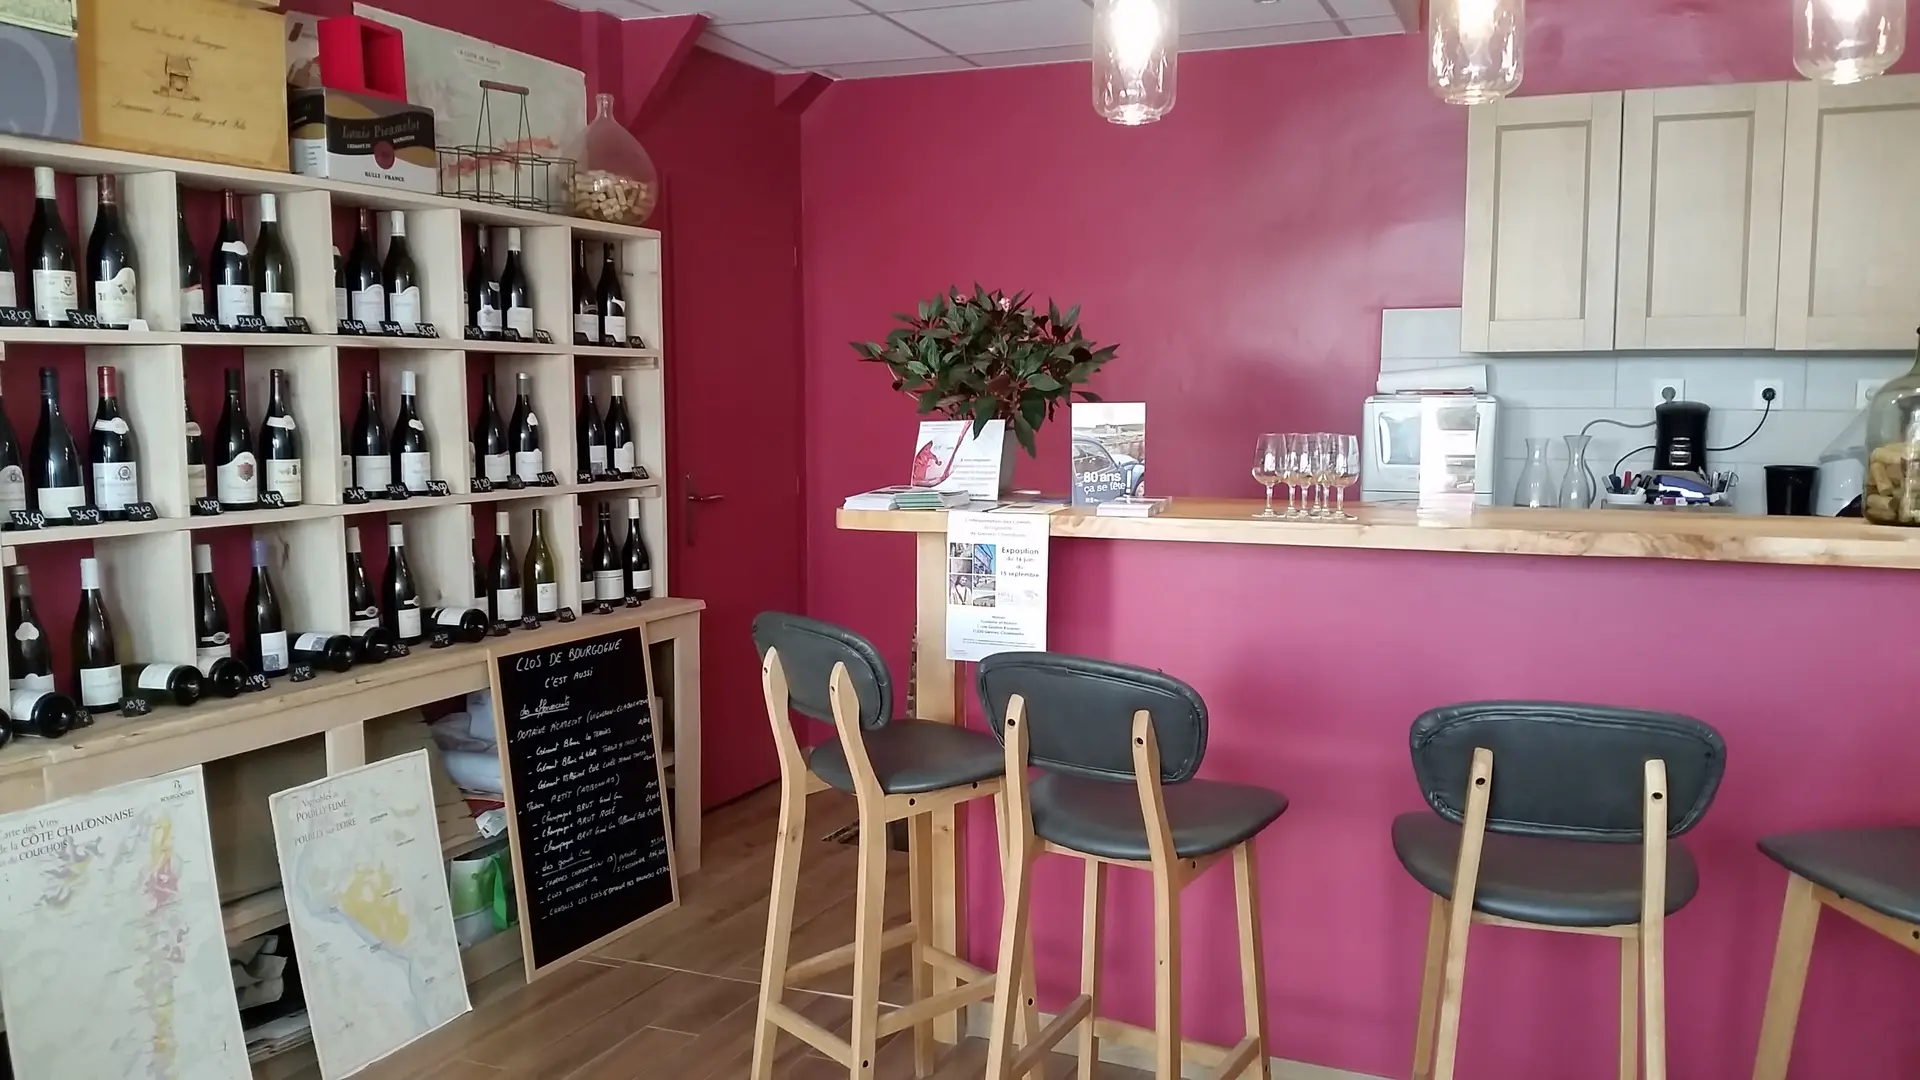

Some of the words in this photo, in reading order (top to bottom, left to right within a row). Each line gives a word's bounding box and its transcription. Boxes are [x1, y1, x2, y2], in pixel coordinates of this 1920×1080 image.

[1083, 471, 1098, 483] 80
[1099, 473, 1121, 482] ans
[1083, 485, 1096, 497] ça
[1001, 546, 1039, 555] Exposition
[516, 655, 541, 672] CLOS
[549, 652, 563, 667] DE
[568, 638, 622, 661] BOURGOGNE
[544, 675, 568, 688] C'EST
[21, 831, 54, 848] CÔTE
[56, 807, 135, 838] CHALONNAISE
[19, 839, 68, 861] COUCHOIS
